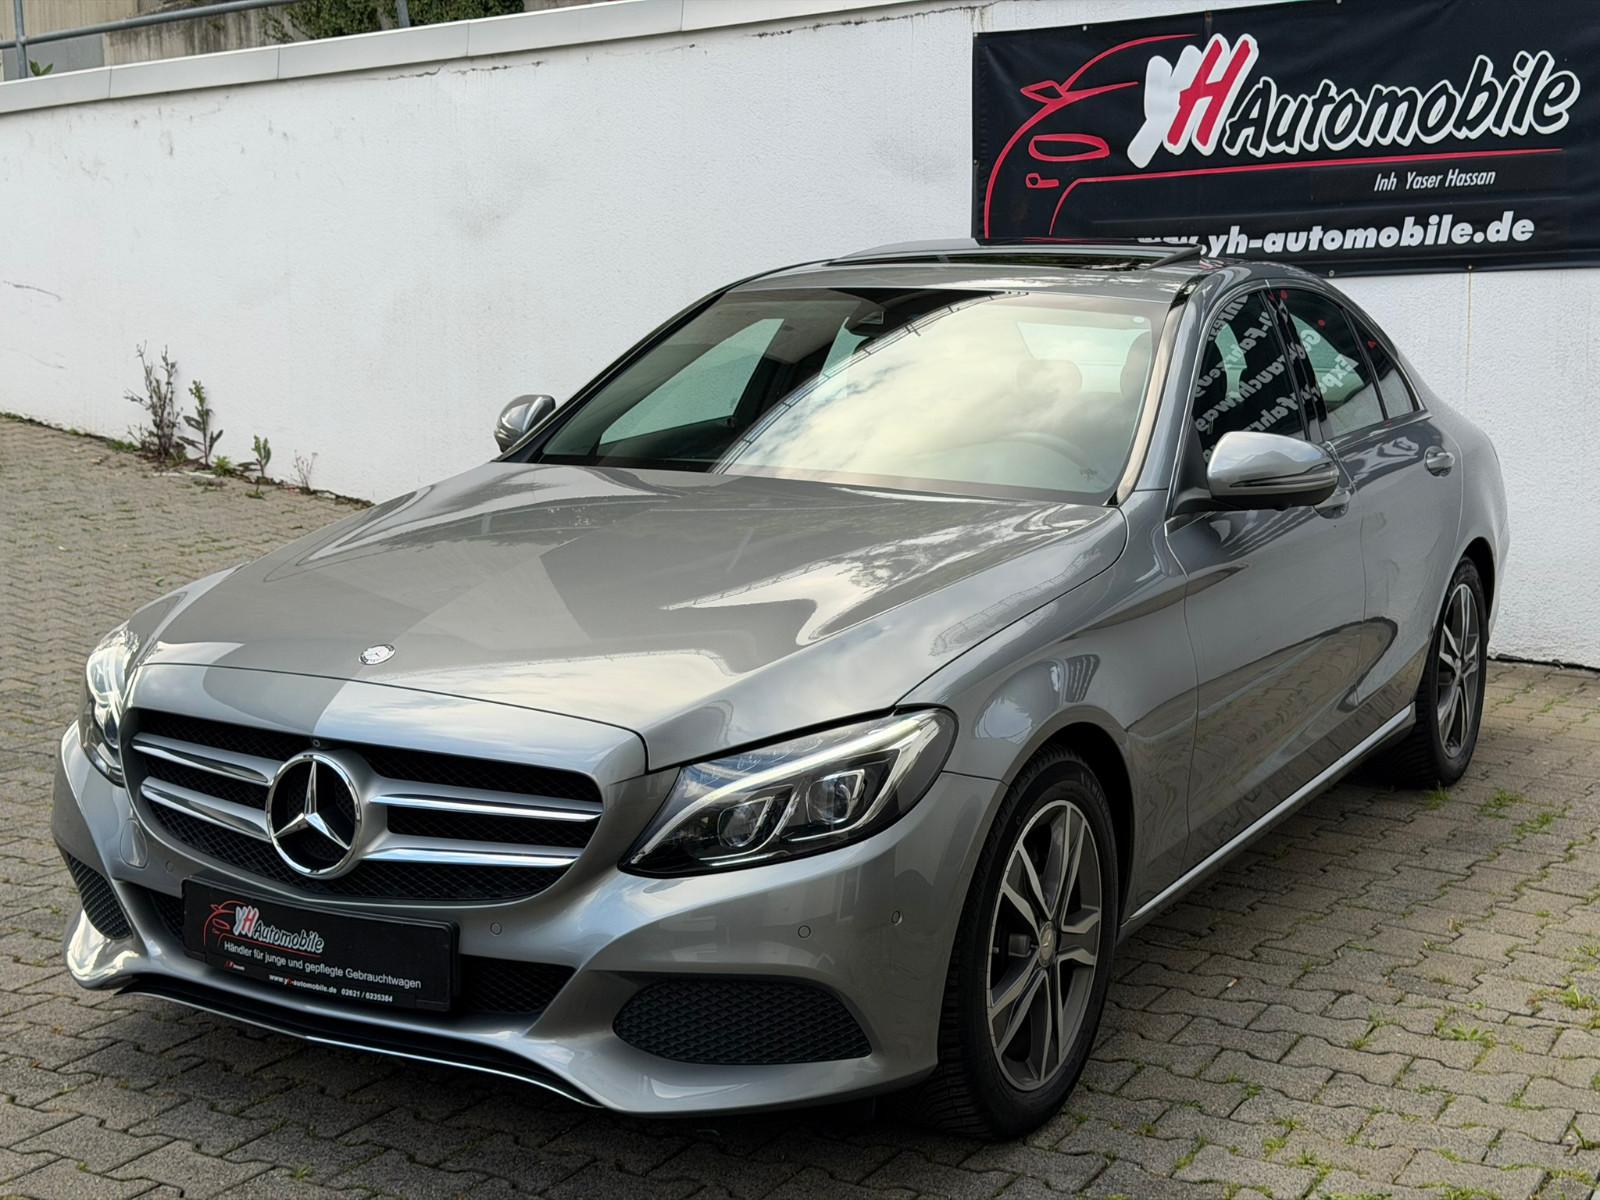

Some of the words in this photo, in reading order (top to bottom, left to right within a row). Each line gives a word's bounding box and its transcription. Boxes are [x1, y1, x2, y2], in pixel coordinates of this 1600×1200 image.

[1374, 171, 1397, 192] Inh
[1404, 172, 1442, 190] Yaser
[1444, 168, 1496, 188] Hassan
[224, 941, 252, 957] Händler
[253, 949, 264, 961] für
[264, 952, 287, 967] junge
[287, 957, 304, 970] und
[304, 960, 344, 978] gepflegte
[345, 967, 422, 989] Gebrauchtwagen
